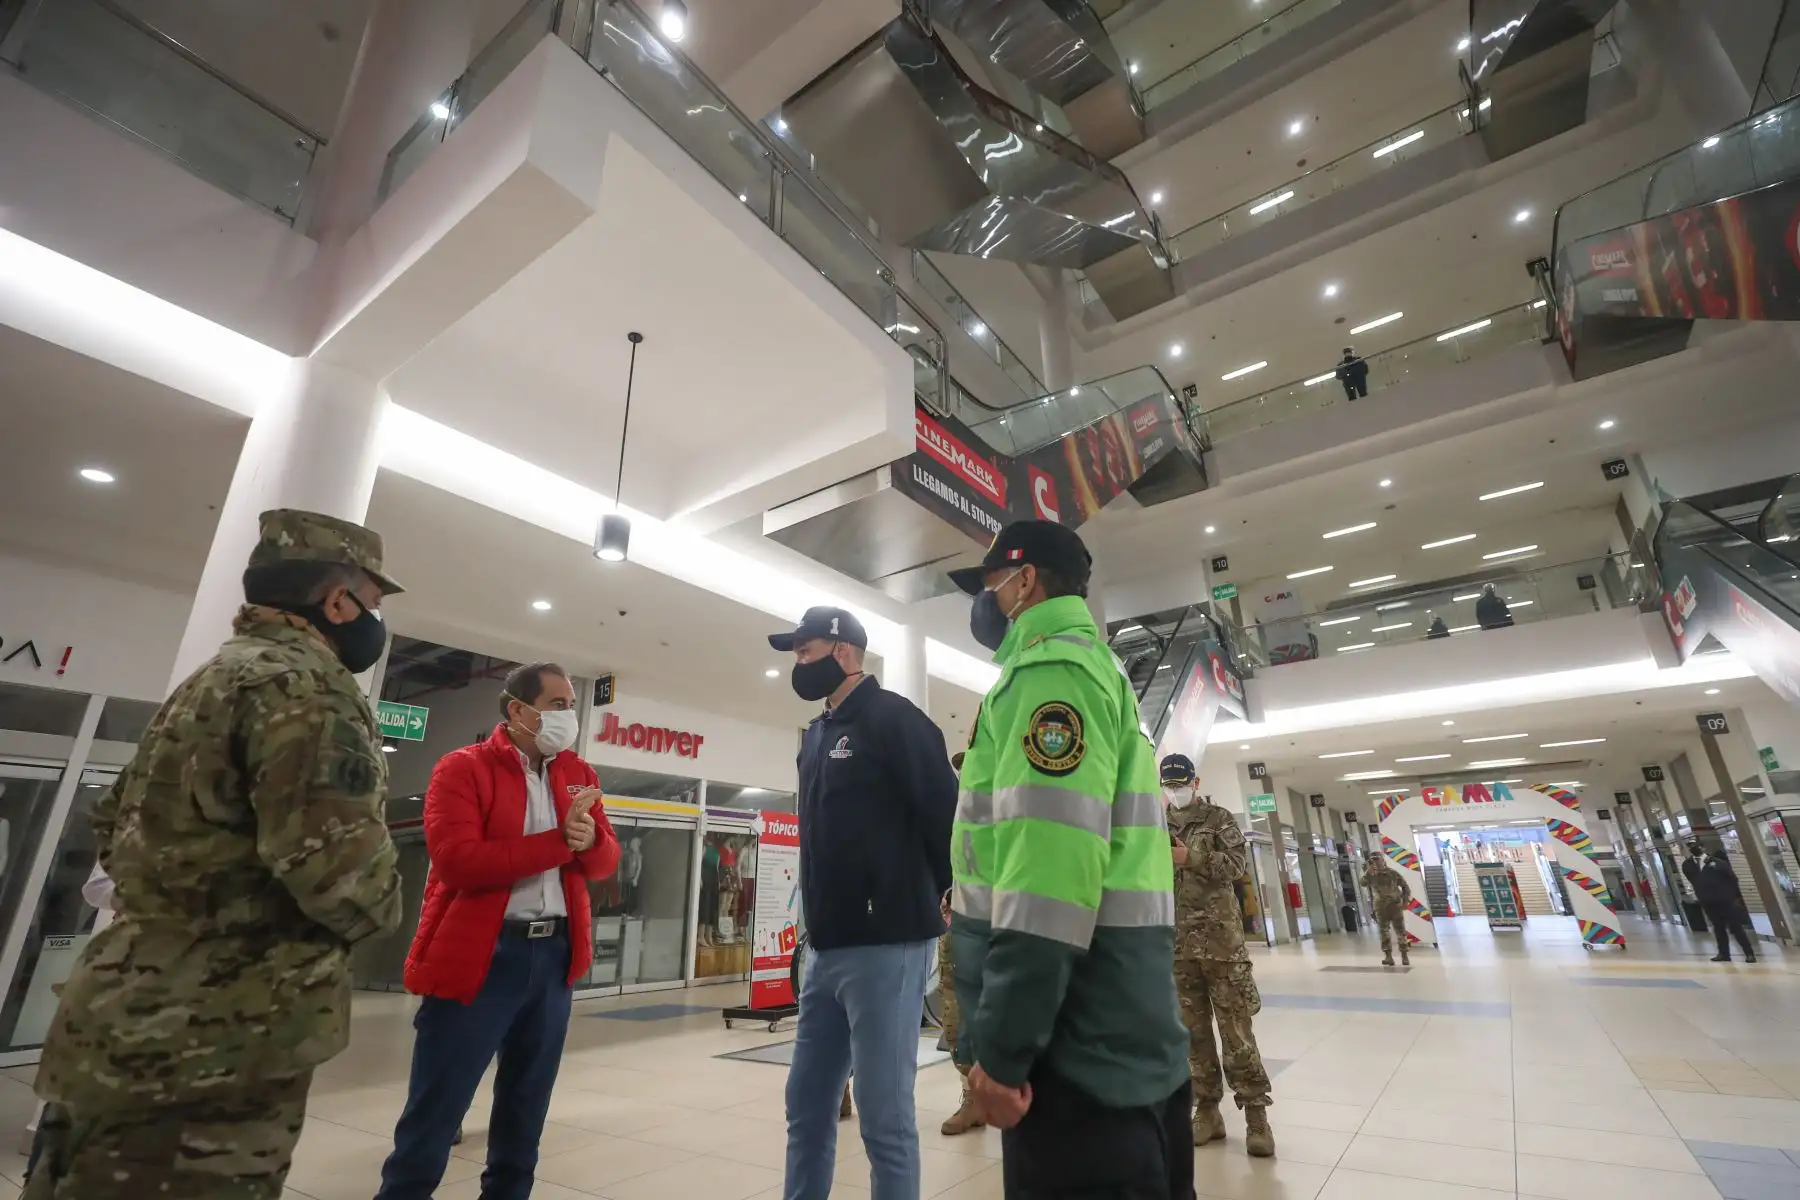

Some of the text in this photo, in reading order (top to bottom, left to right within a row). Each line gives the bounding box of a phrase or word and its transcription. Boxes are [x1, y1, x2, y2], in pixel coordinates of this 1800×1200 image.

[1609, 463, 1626, 475] 09
[912, 463, 960, 508] LLEGAMOS
[960, 495, 971, 516] AL
[971, 503, 986, 526] 5TO
[1216, 559, 1227, 569] 10
[830, 617, 839, 635] 1
[600, 682, 611, 699] 15
[376, 711, 405, 729] SALIDA
[1707, 718, 1725, 731] 09
[594, 711, 704, 760] Jhonver
[1254, 766, 1265, 776] 10
[768, 819, 799, 837] TÓPICO
